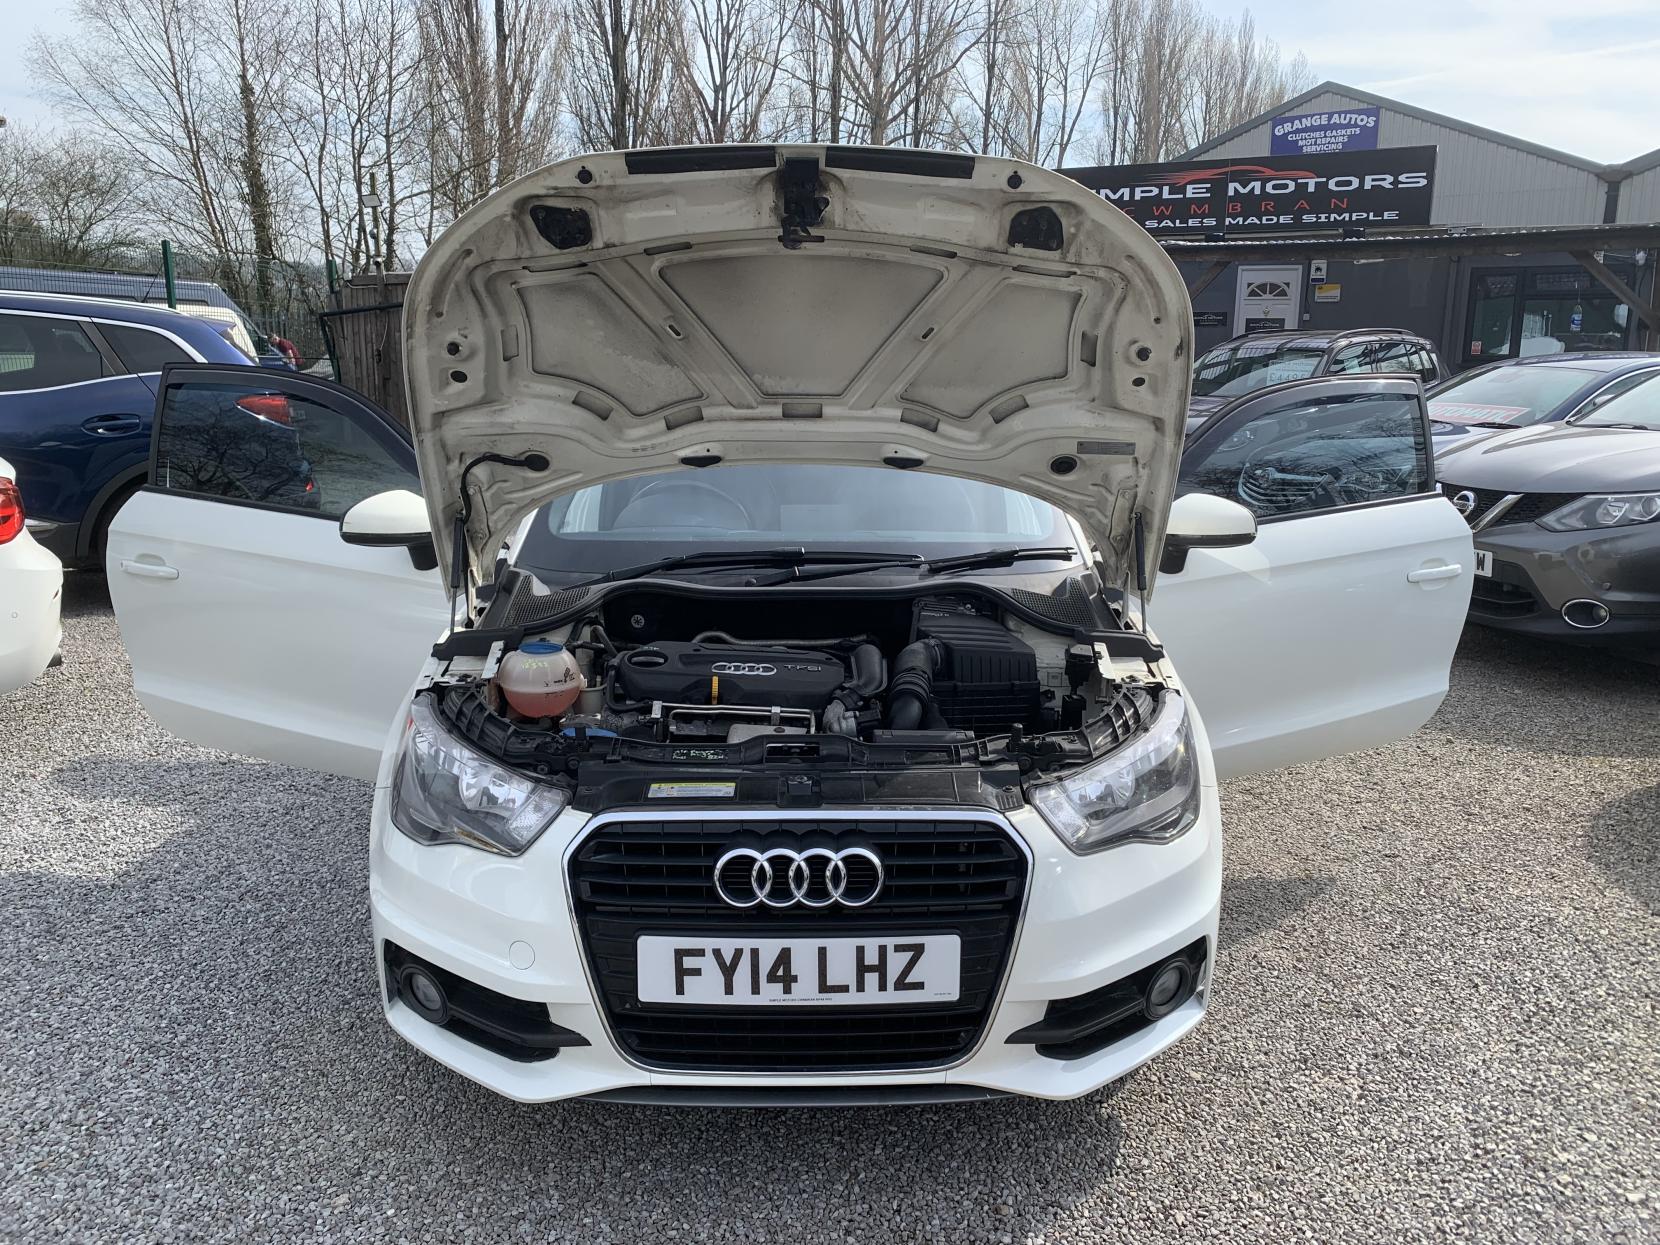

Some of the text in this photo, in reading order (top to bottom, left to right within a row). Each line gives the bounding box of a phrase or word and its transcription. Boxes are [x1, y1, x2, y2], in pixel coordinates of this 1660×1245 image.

[1274, 114, 1377, 136] GRANGE AUTOS
[1287, 128, 1361, 141] CLUTCHES GASKETS
[1317, 136, 1348, 145] REPAIRS
[1302, 143, 1343, 153] SERVICING
[1091, 172, 1428, 201] MPLE MOTORS
[1144, 211, 1400, 228] SALES MADE SIMPLE
[1429, 406, 1509, 422] UTOMATIC
[673, 943, 926, 996] FY14 LHZ
